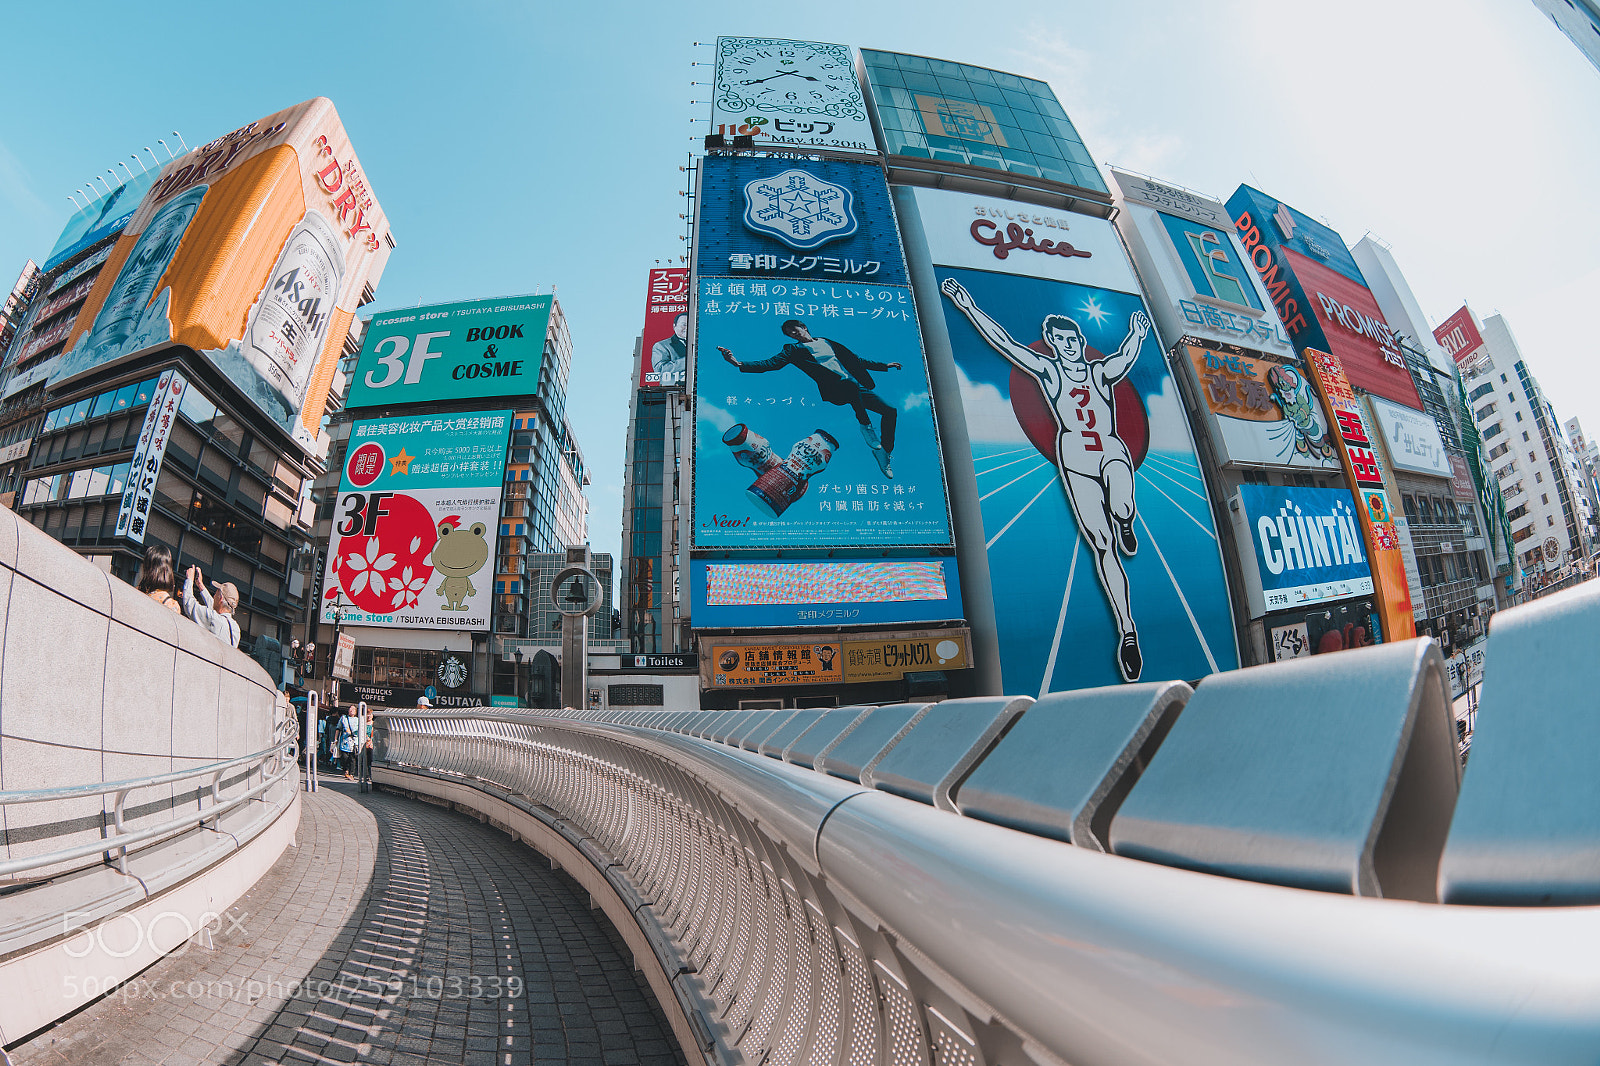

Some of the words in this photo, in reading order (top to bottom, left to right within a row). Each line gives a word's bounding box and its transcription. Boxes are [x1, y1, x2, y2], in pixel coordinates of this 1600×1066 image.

[738, 56, 757, 66] 10
[757, 51, 772, 59] 11
[828, 74, 843, 82] 3
[785, 92, 798, 100] 6
[809, 90, 822, 99] 5
[774, 118, 836, 135] ピップ
[728, 253, 881, 275] 雪印メグミルク
[1234, 210, 1307, 337] PROMISE
[705, 282, 908, 304] 道頓堀のおいしいものと
[274, 266, 327, 339] Asahi
[419, 310, 449, 321] store
[456, 306, 493, 317] TSUTAYA
[494, 302, 546, 313] EBISUBASHI
[1316, 291, 1400, 352] PROMISE
[280, 319, 298, 346] 生
[466, 323, 525, 343] BOOK
[483, 343, 499, 359] &
[364, 330, 451, 389] 3F
[1203, 350, 1258, 377] かぜに
[451, 360, 524, 381] COSME
[726, 395, 816, 408] 軽々、つづく。
[1068, 384, 1104, 452] グリコ
[131, 455, 159, 537] かに道楽
[818, 483, 917, 496] ガセリ菌SP株が
[818, 499, 925, 512] 内臓脂肪を減らす
[337, 492, 395, 538] 3F
[702, 513, 751, 529] New!
[1257, 499, 1365, 575] CHINTAI
[365, 612, 393, 623] store
[400, 615, 435, 625] TSUTAYA
[436, 616, 485, 626] EBISUBASHI
[797, 608, 860, 620] 雪印メグミルク
[648, 656, 684, 666] Toilets
[744, 649, 812, 662] 店舗情報館
[883, 643, 933, 667] ピタットハウス
[354, 686, 393, 696] STARBUCKS
[361, 693, 386, 702] COFFEE
[435, 695, 484, 707] TSUTAYA
